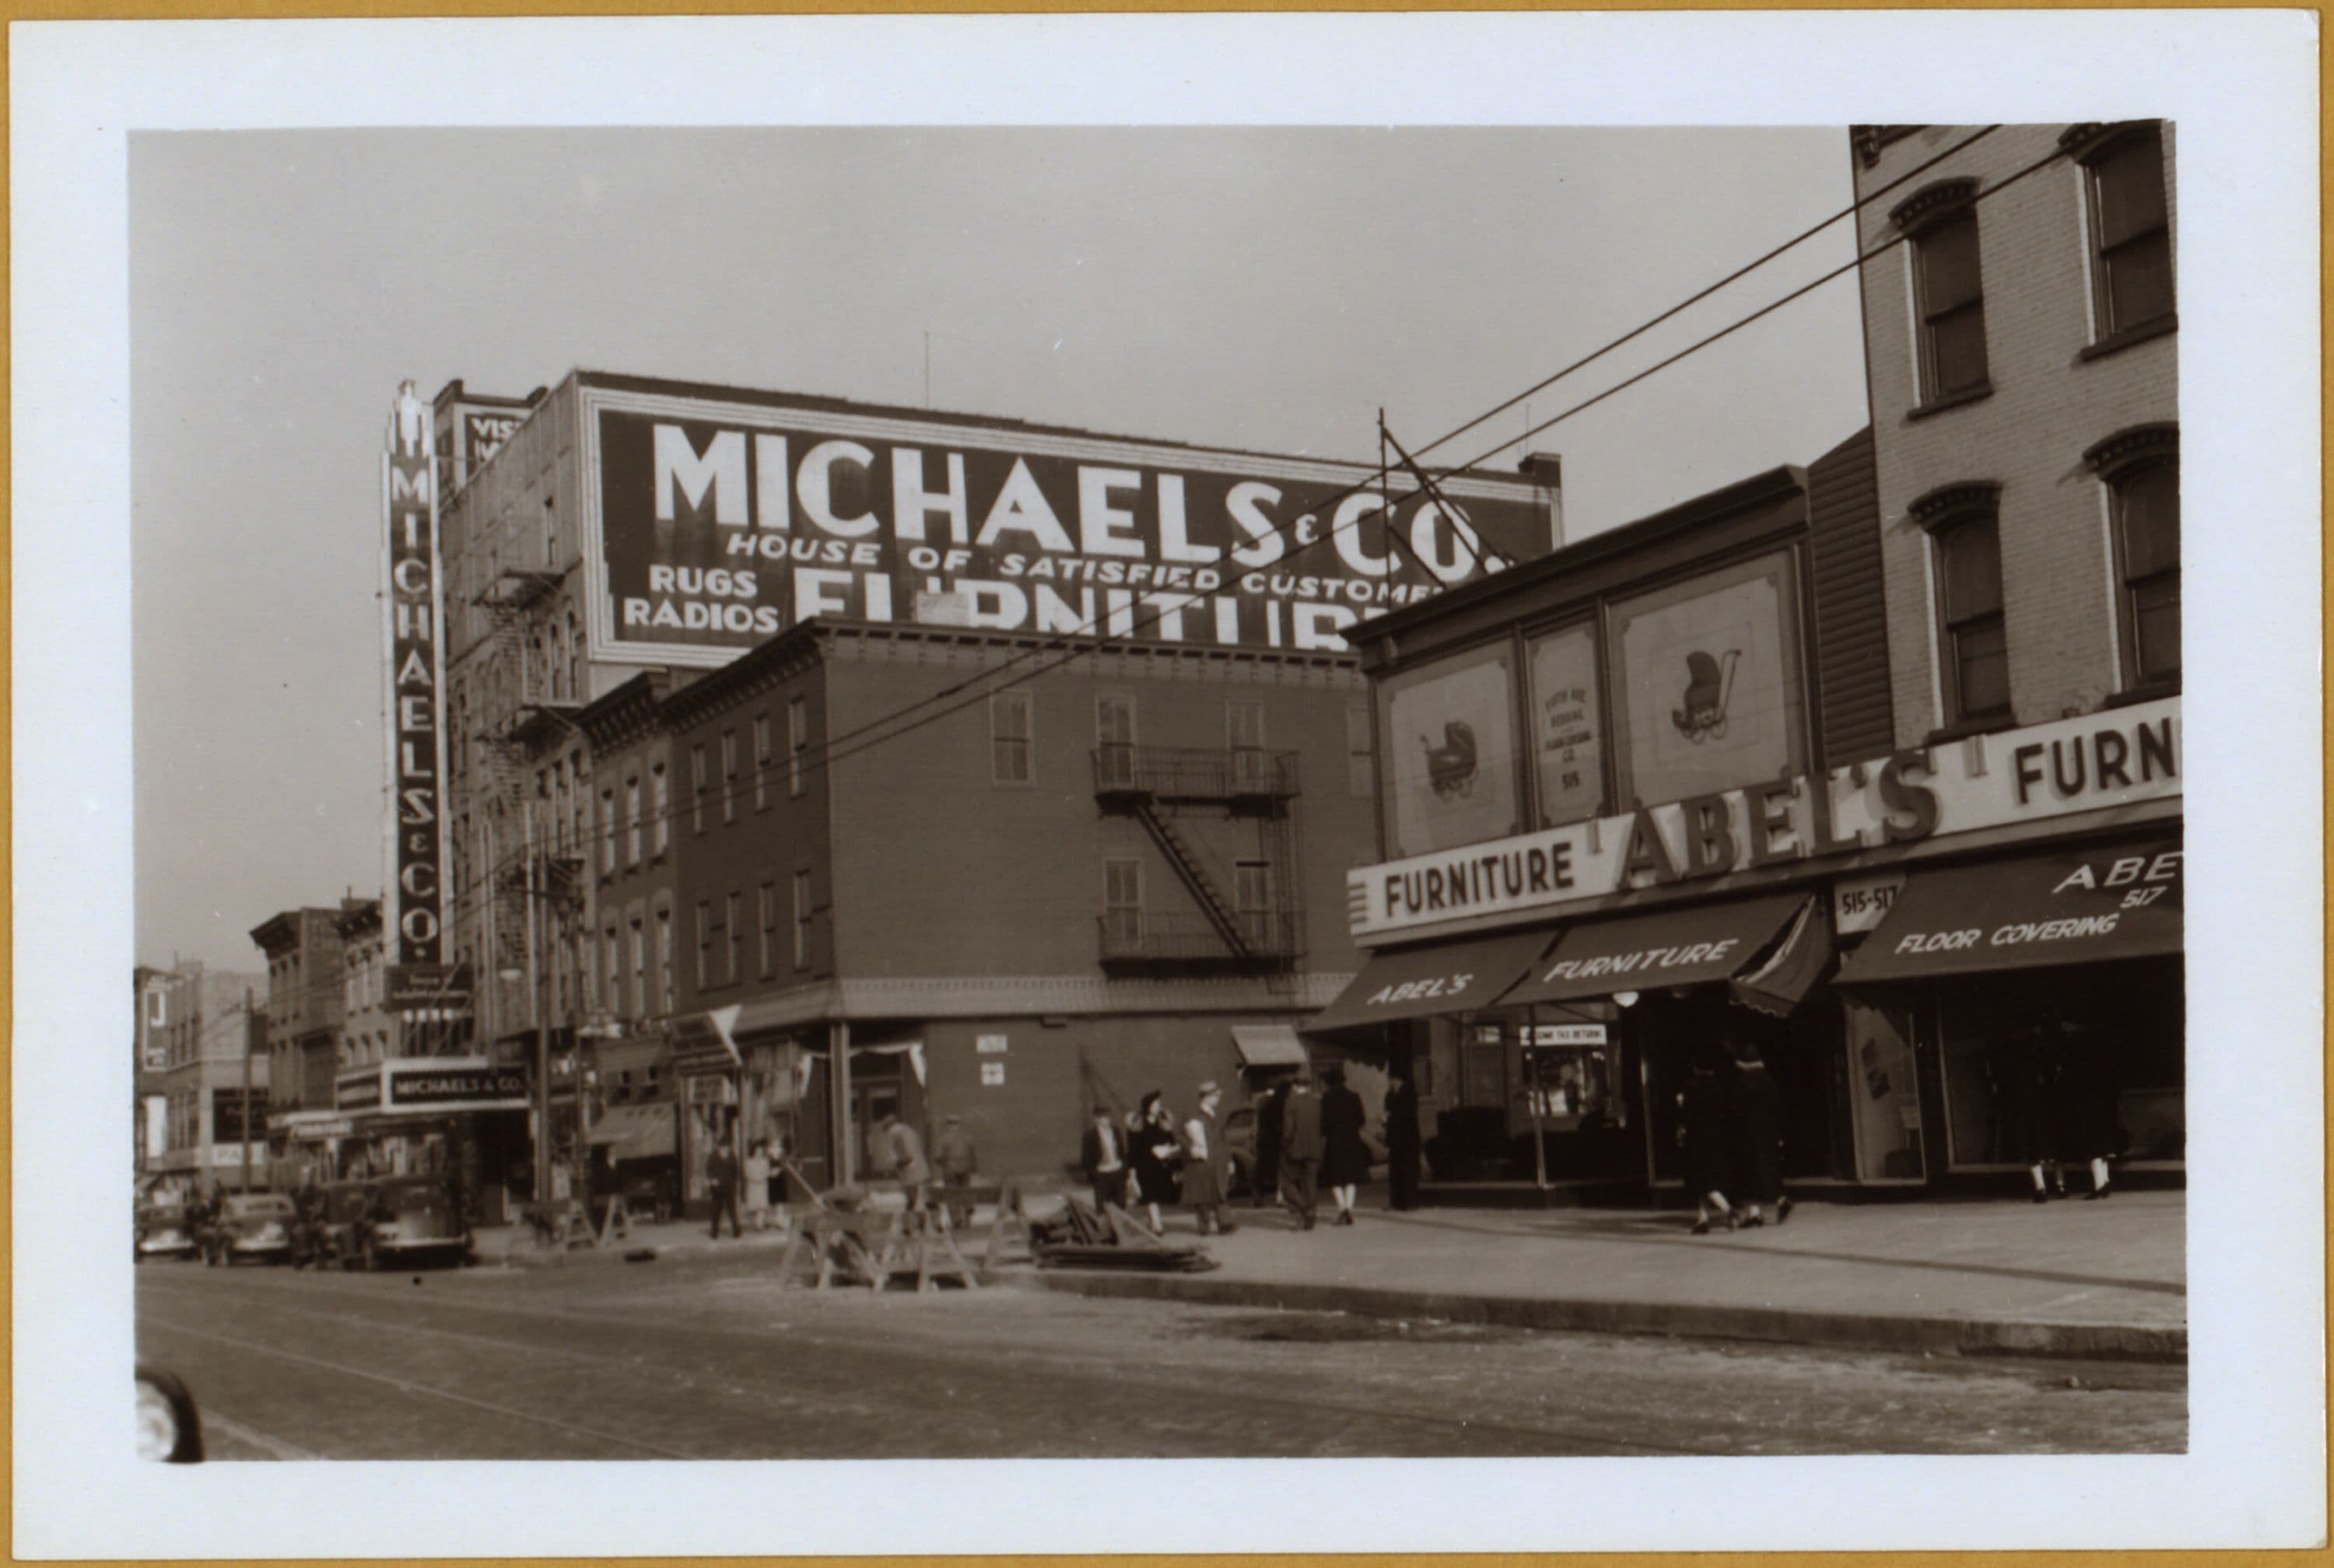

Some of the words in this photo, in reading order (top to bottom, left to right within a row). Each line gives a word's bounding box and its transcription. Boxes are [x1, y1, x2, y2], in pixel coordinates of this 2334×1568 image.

[654, 423, 1285, 569] MICHAELS
[1295, 513, 1319, 544] &
[1332, 492, 1506, 582] CO.
[649, 564, 757, 597] RUGS
[727, 534, 881, 565] HOUSE
[908, 547, 972, 570] OF
[1000, 553, 1220, 590] SATISFIED
[1242, 572, 1445, 604] CUSTOME
[624, 598, 779, 633] RADIOS
[391, 466, 435, 824] MICHAELS
[1616, 748, 1937, 890] ABEL'S
[409, 832, 428, 852] &
[1383, 842, 1575, 919] FURNITURE
[2120, 886, 2168, 908] 517
[1842, 885, 1898, 915] 515-517
[1894, 929, 1982, 954] FLOOR
[1991, 913, 2121, 947] COVERING
[1544, 939, 1740, 983] FURNITURE
[1367, 974, 1474, 1006] ABEL'S
[396, 1077, 480, 1094] MICHAELS
